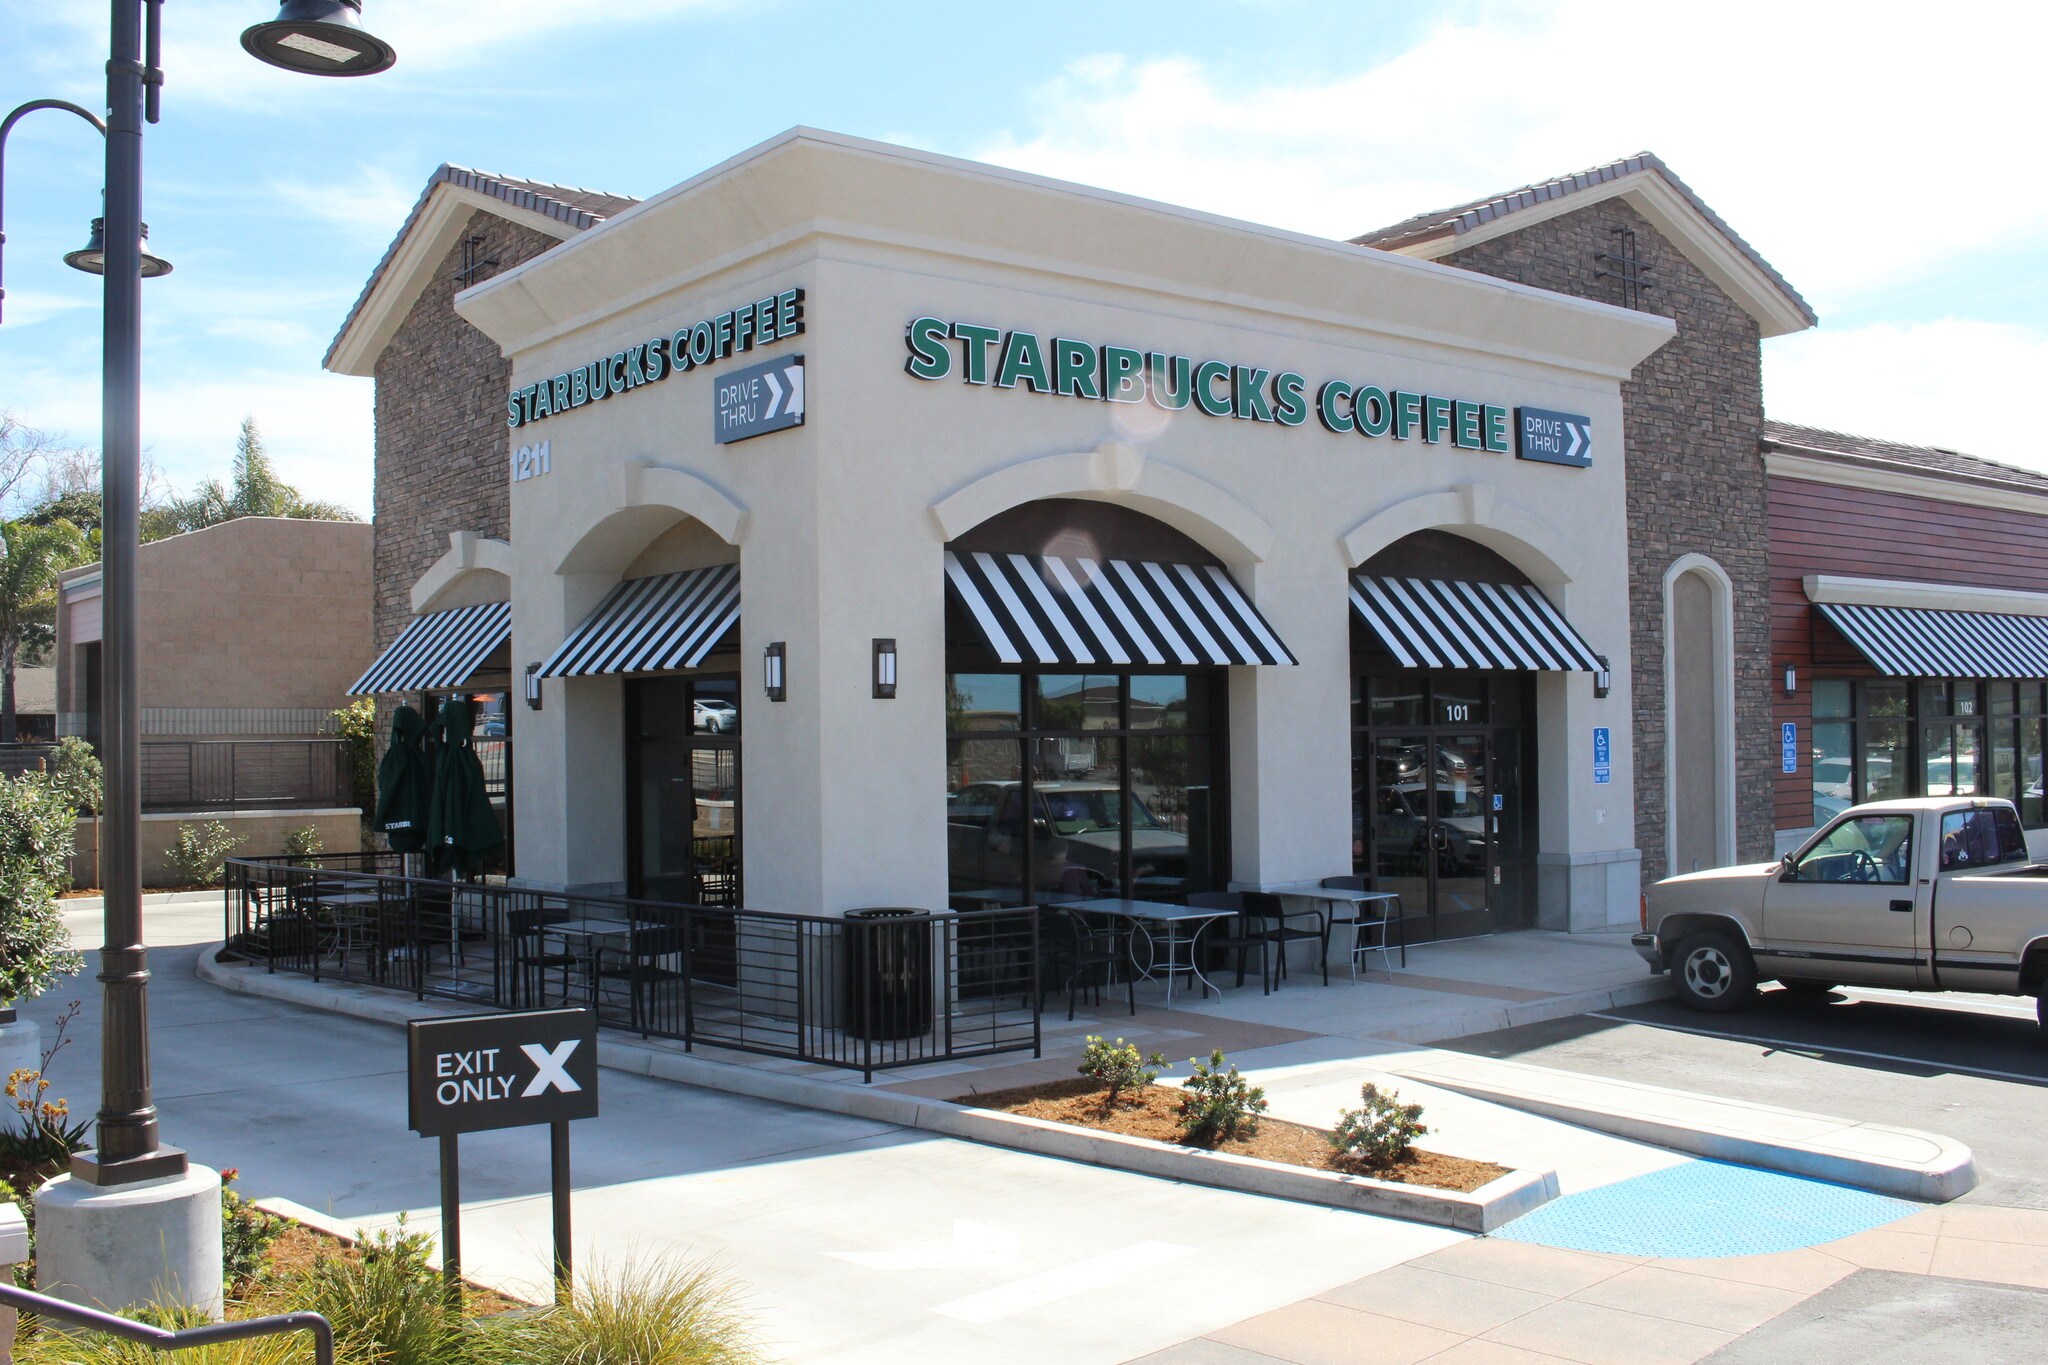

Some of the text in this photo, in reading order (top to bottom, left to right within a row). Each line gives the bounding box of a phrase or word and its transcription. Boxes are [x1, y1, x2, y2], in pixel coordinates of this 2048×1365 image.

[507, 288, 804, 428] STARBUCKS COFFEE
[720, 378, 759, 408] DRIVE
[905, 316, 1508, 453] STARBUCKS COFFEE
[720, 407, 757, 430] THRU
[1526, 416, 1562, 437] DRIVE
[1527, 434, 1560, 453] THRU
[510, 439, 550, 482] 1211
[1446, 705, 1468, 721] 101
[1960, 701, 1973, 714] 102
[436, 1048, 500, 1078] EXIT
[436, 1074, 516, 1106] ONLY
